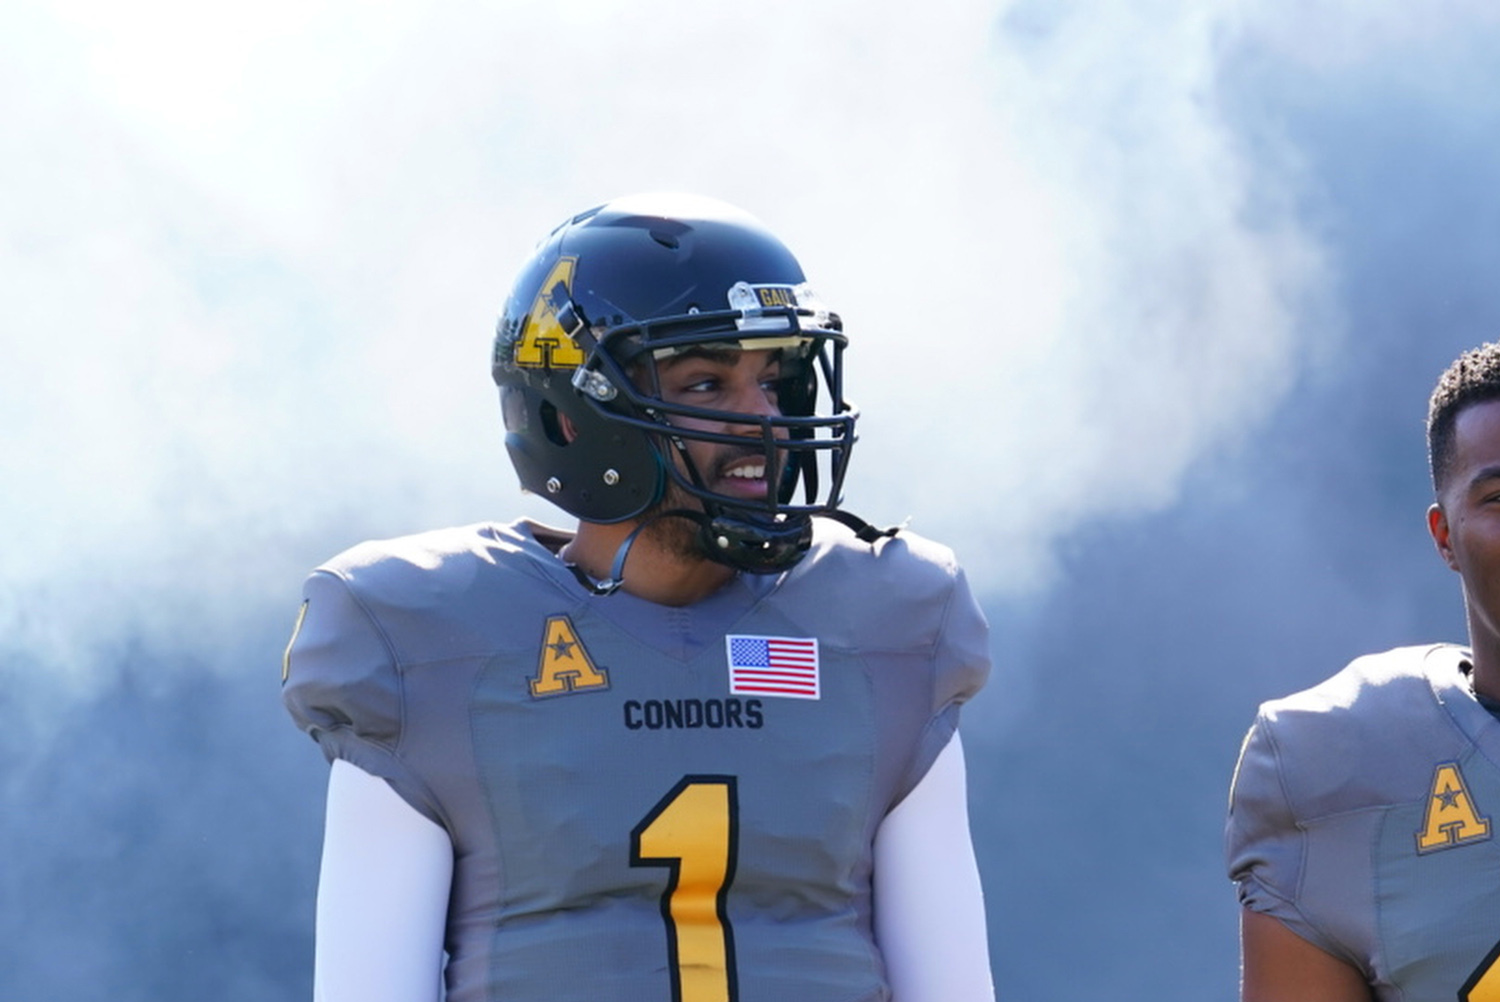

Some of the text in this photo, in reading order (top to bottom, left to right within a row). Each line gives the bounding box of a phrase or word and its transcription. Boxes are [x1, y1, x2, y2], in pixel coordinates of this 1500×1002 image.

[514, 255, 587, 370] A
[759, 288, 792, 308] GAU
[525, 612, 610, 699] A
[623, 699, 764, 730] CONDORS
[1415, 761, 1492, 856] A
